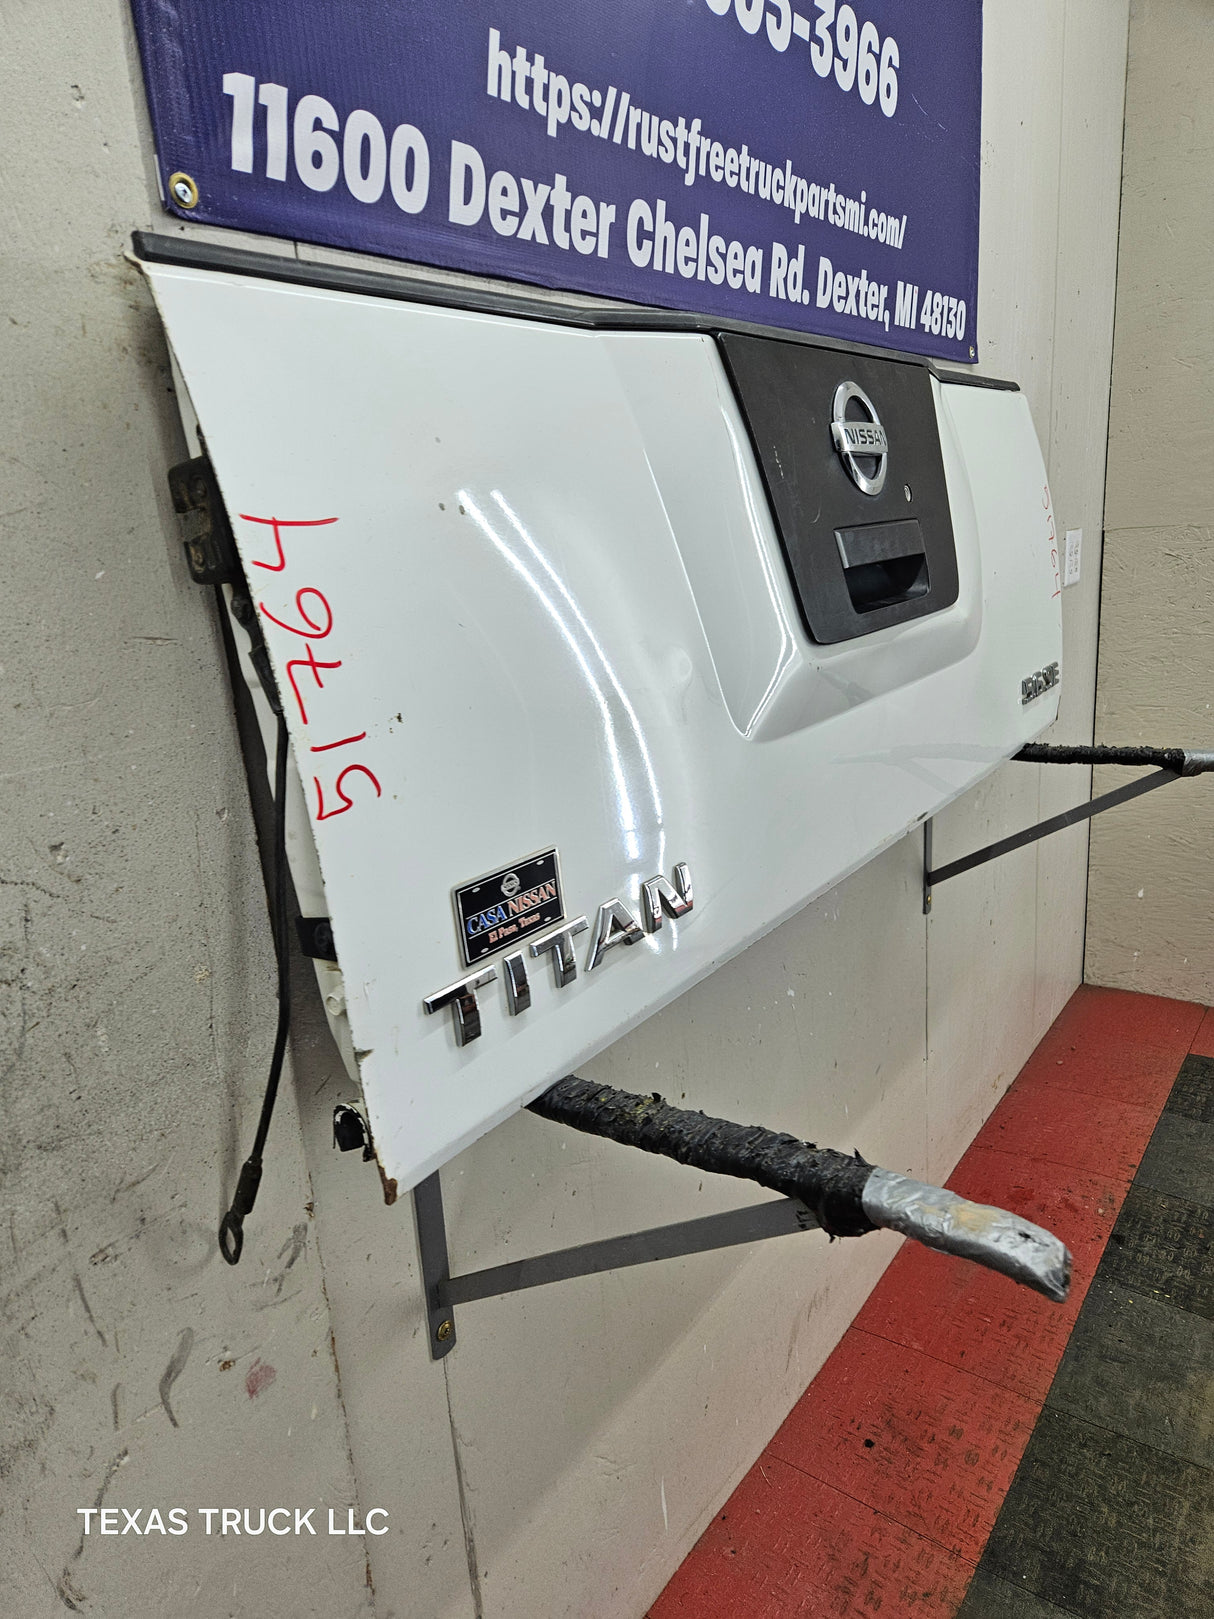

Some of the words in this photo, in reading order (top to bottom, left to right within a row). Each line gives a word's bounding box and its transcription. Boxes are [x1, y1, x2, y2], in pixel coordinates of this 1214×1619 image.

[223, 72, 430, 214] 11600
[448, 140, 617, 258] Dexter
[626, 198, 764, 294] Chelsea
[770, 242, 811, 304] Rd.
[815, 256, 890, 333] Dexter,
[894, 280, 919, 330] MI
[920, 290, 967, 341] 48130
[487, 28, 908, 250] https://rustfreetruckpartsmi.com/
[843, 427, 888, 447] NISSAN
[239, 513, 382, 821] 51764
[423, 861, 695, 1048] TITAN
[466, 905, 508, 935] CASA
[507, 881, 557, 917] NISSAN
[518, 912, 541, 928] Texas
